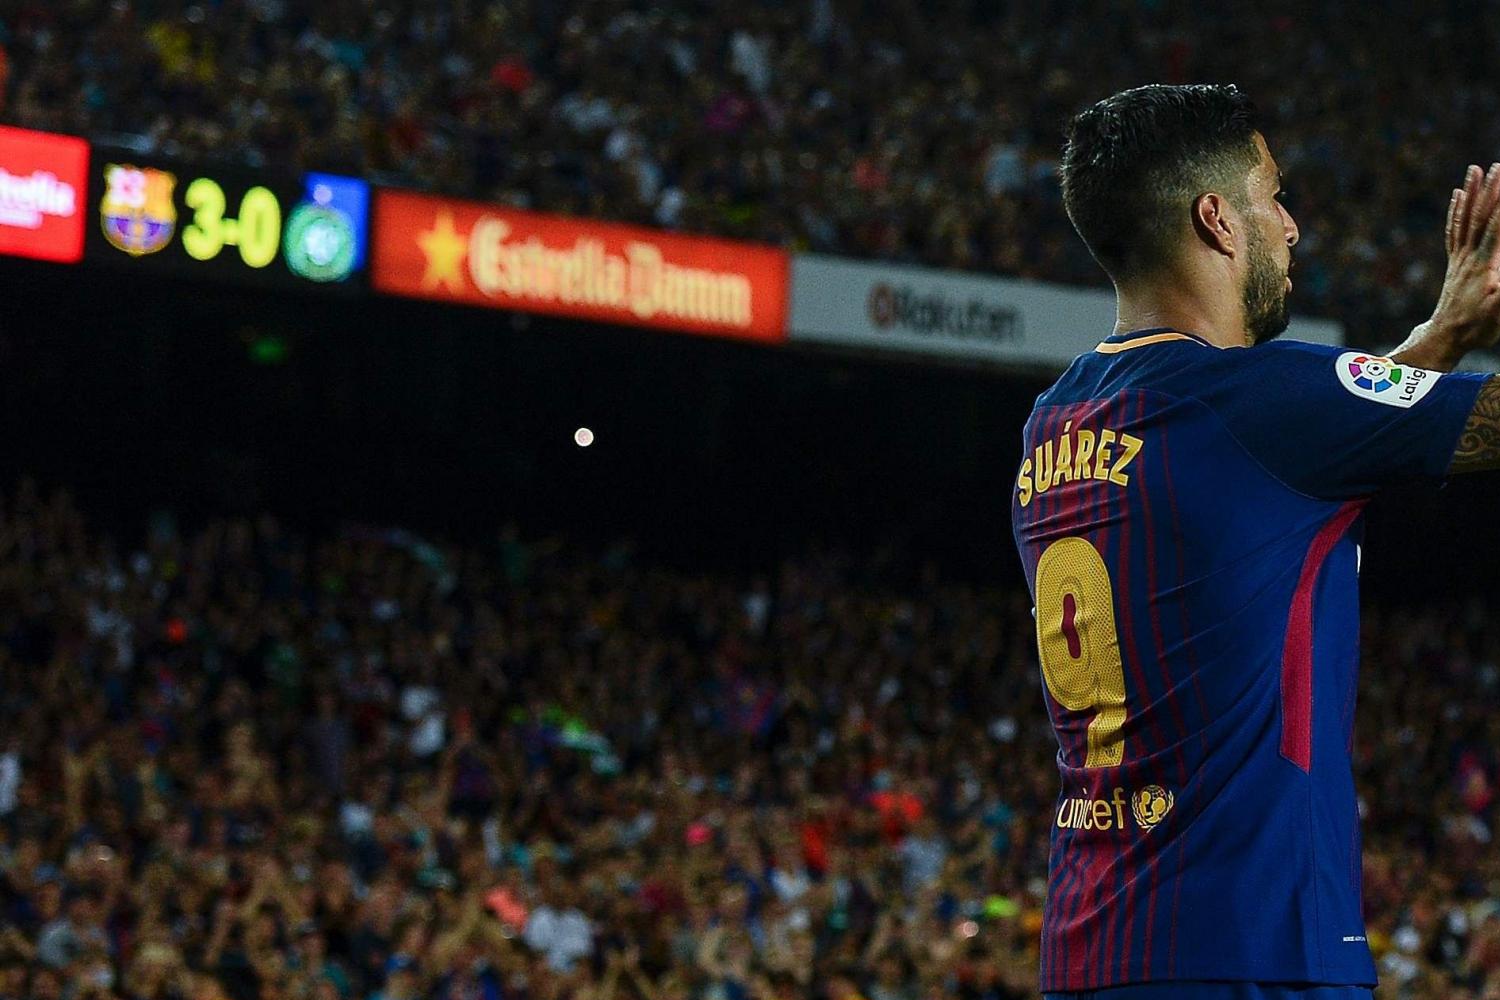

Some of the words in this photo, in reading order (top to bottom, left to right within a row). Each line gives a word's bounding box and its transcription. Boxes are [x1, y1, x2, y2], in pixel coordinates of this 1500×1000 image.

[182, 176, 282, 270] 3-0
[1399, 368, 1427, 402] LaLig
[1017, 420, 1145, 508] SUÁREZ
[1035, 536, 1128, 769] 9
[1056, 787, 1126, 831] unicef
